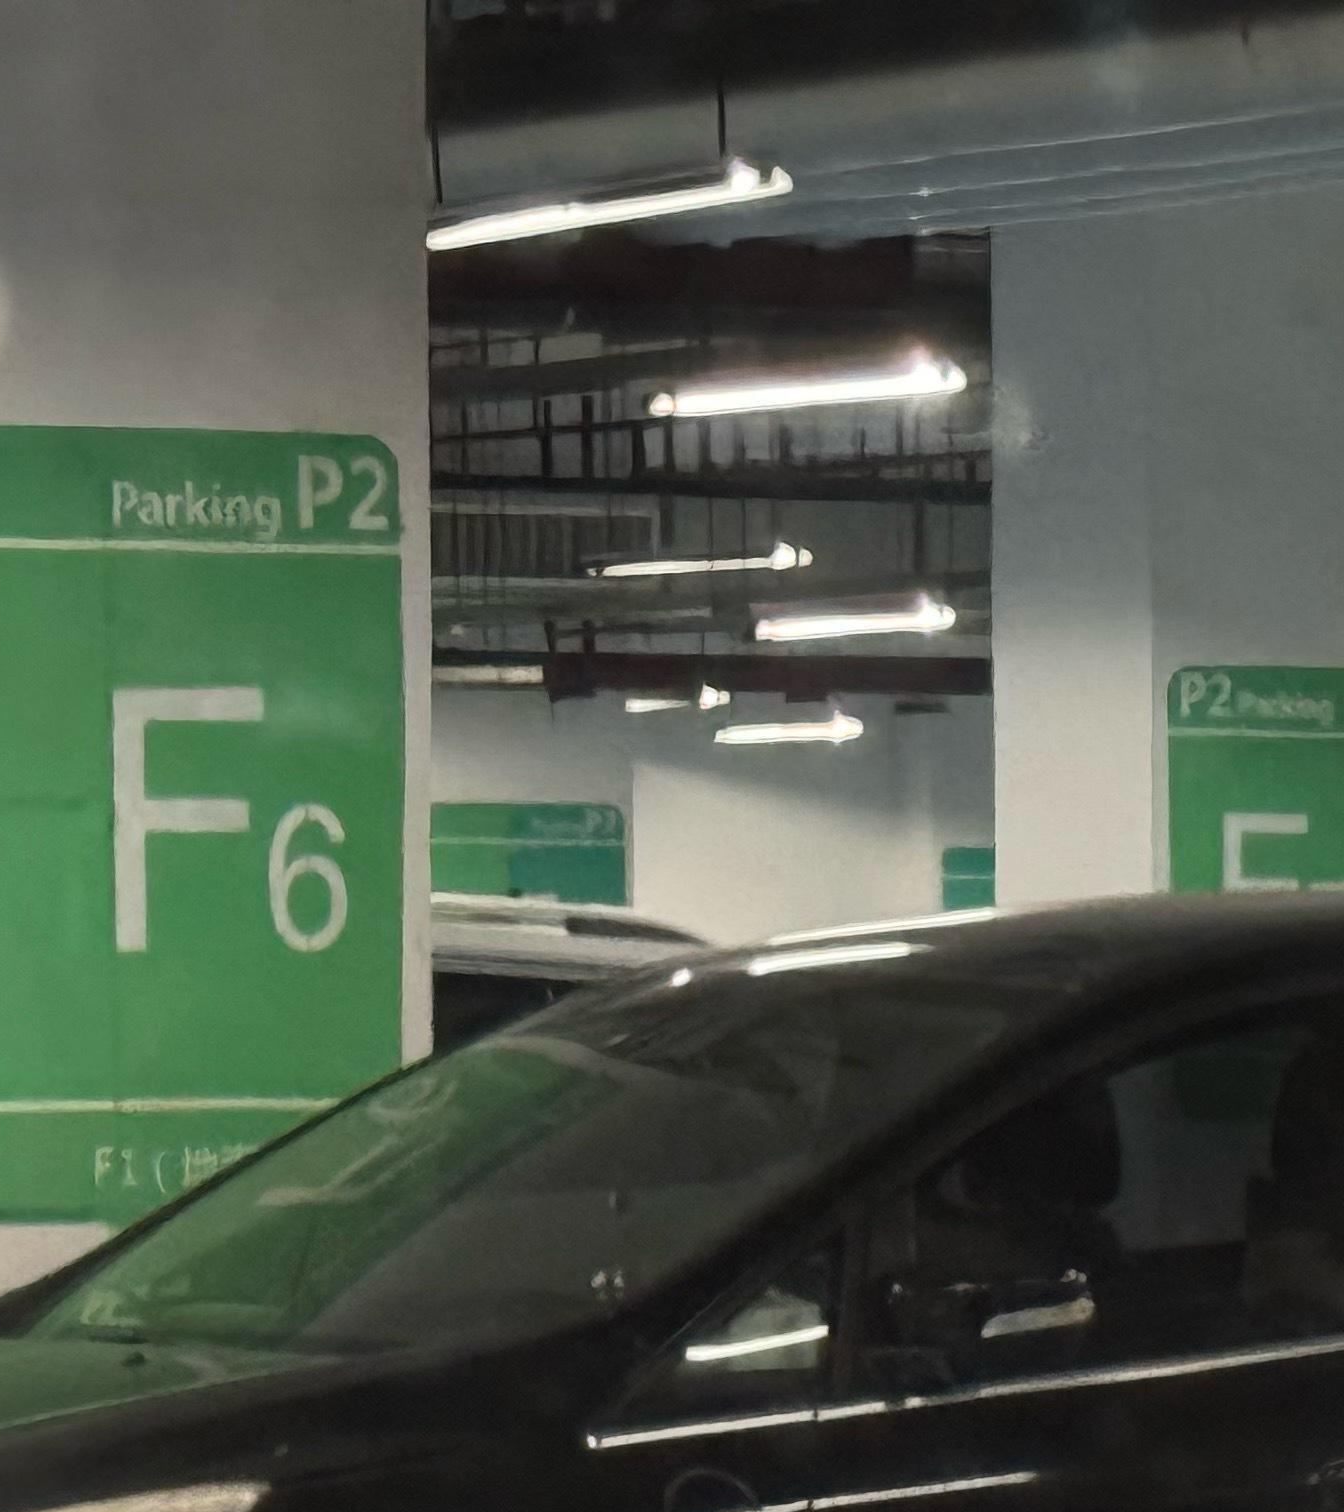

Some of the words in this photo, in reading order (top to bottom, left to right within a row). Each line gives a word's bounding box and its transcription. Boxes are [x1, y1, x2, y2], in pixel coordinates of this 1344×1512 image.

[112, 480, 281, 541] Parking
[298, 454, 390, 531] P2
[1180, 671, 1233, 717] P2
